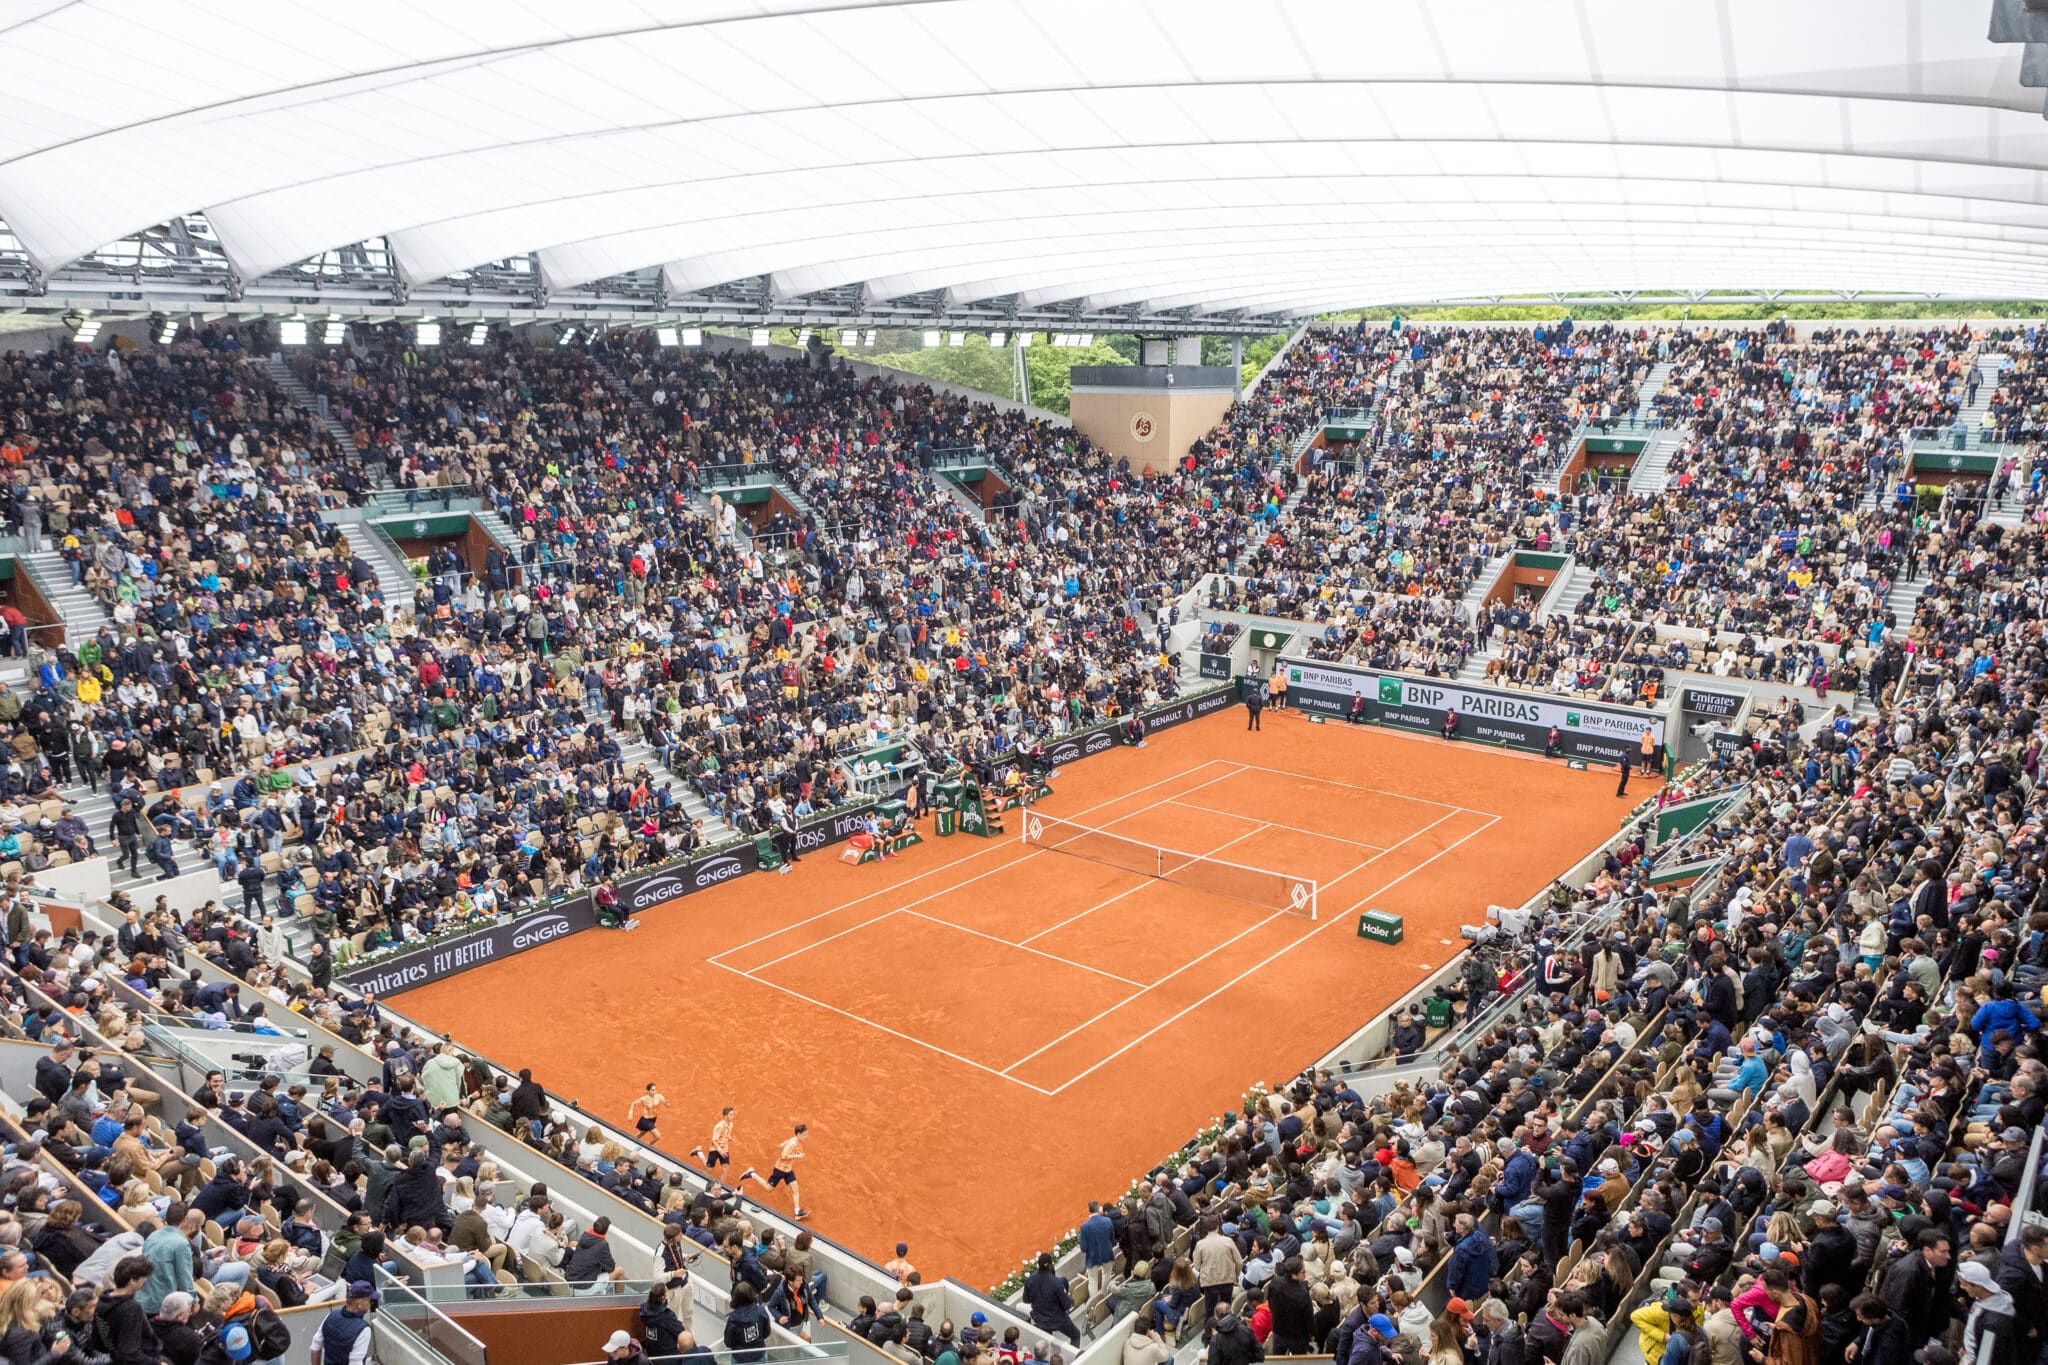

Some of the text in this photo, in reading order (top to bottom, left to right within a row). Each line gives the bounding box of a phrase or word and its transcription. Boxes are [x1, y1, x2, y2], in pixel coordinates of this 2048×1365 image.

[1202, 667, 1226, 677] ROLEX
[1303, 672, 1319, 681] BNP
[1320, 674, 1353, 687] PARIBAS
[1198, 695, 1228, 712] RENAULT
[1299, 697, 1341, 710] BNP PARIBAS
[1408, 686, 1540, 722] BNP PARIBAS
[1690, 691, 1735, 707] Emirates
[1695, 702, 1728, 714] FLY BETTER
[1151, 710, 1182, 728] RENAULT
[1384, 711, 1431, 725] BNP PARIBAS
[1583, 715, 1645, 733] BNP PARIBAS
[1477, 727, 1526, 742] BNP PARIBAS
[1576, 743, 1622, 757] BNP PARIBA
[1715, 739, 1739, 750] Emir
[1362, 922, 1389, 938] Haier
[434, 951, 452, 974] FLY
[455, 938, 494, 968] BETTER
